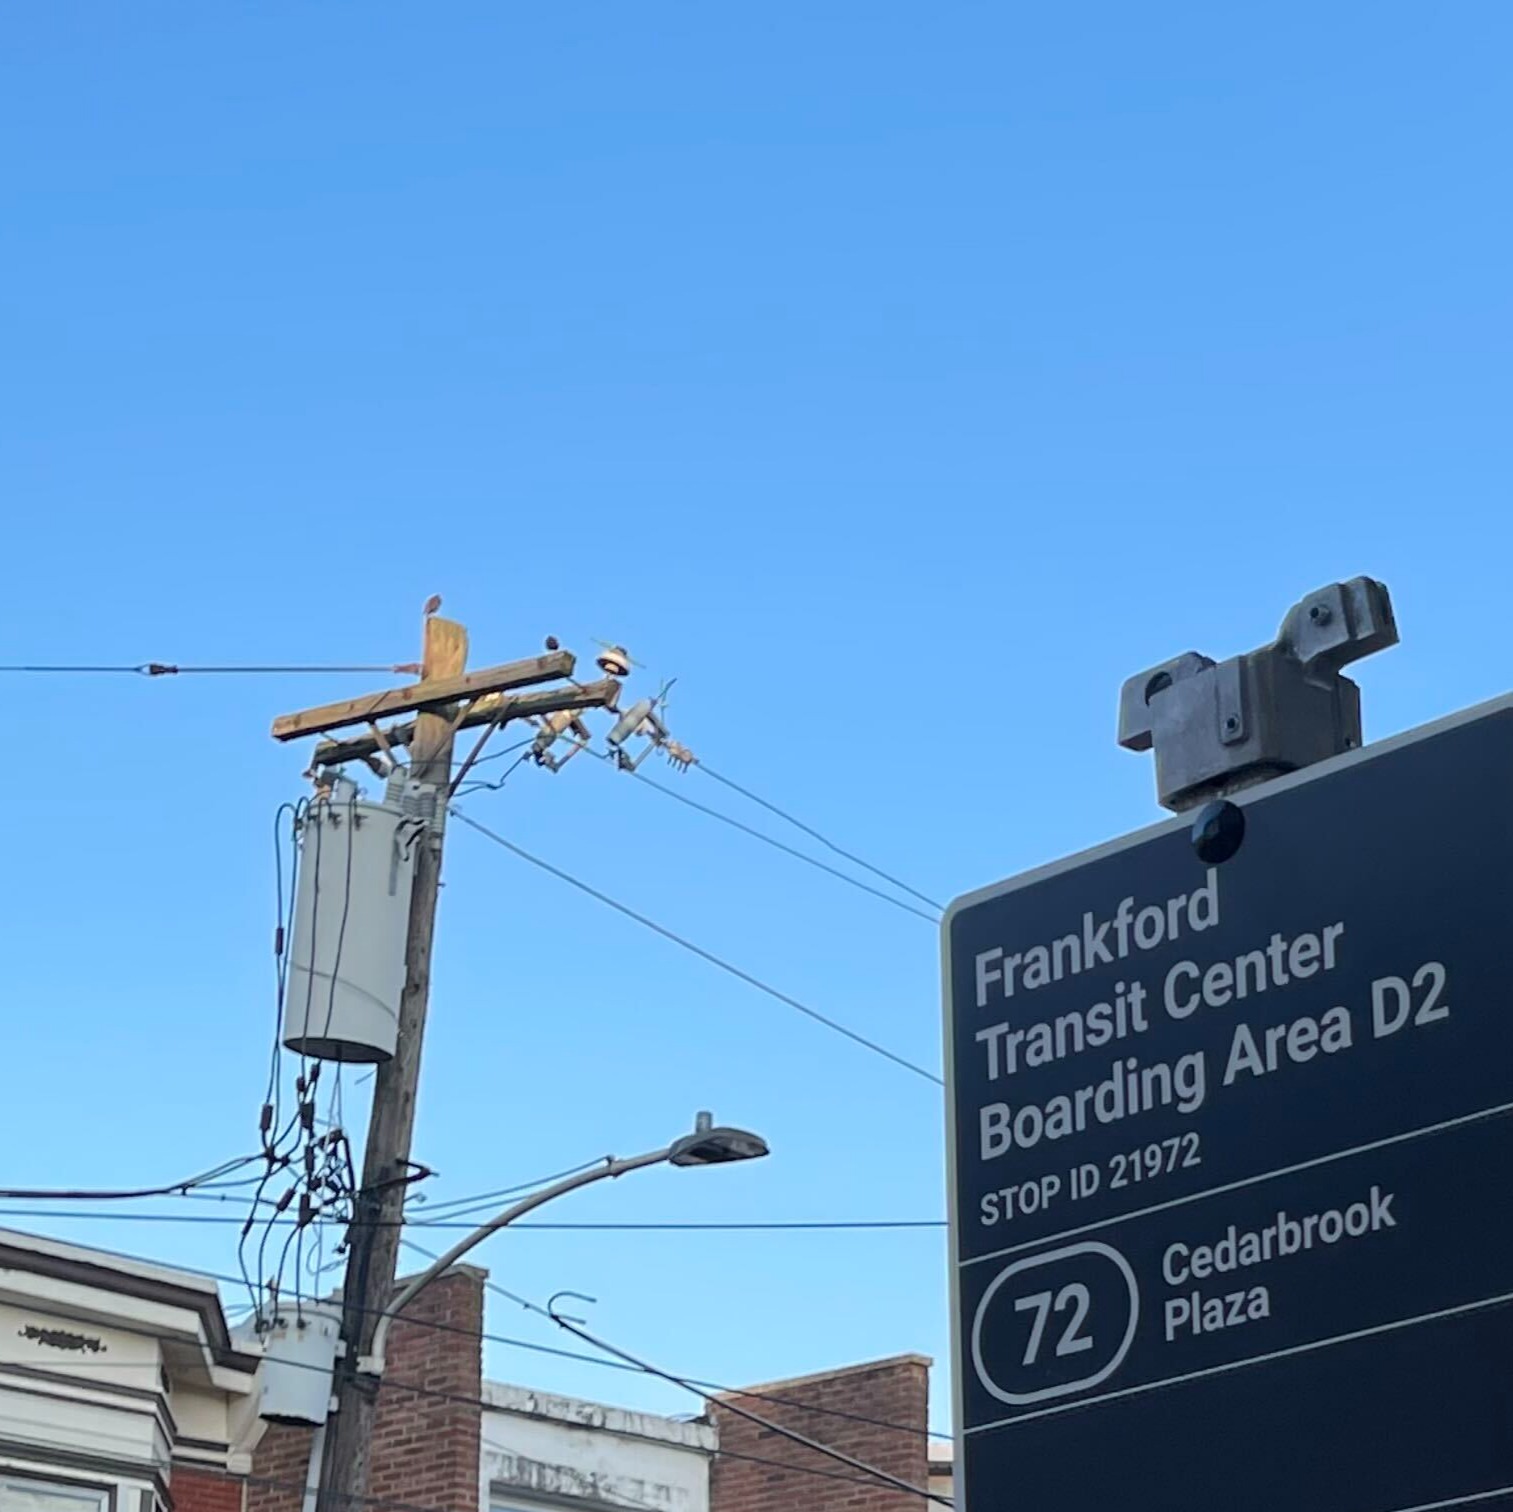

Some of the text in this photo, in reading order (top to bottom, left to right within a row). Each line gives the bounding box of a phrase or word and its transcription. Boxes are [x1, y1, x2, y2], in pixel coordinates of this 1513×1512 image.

[975, 867, 1220, 1007] Frankford
[975, 921, 1344, 1082] Transit Center
[979, 960, 1450, 1160] Boarding Area D2
[979, 1131, 1202, 1226] STOP ID 21972
[1162, 1186, 1397, 1285] Cedarbrook
[1014, 1282, 1094, 1366] 72
[1164, 1284, 1271, 1342] Plaza
